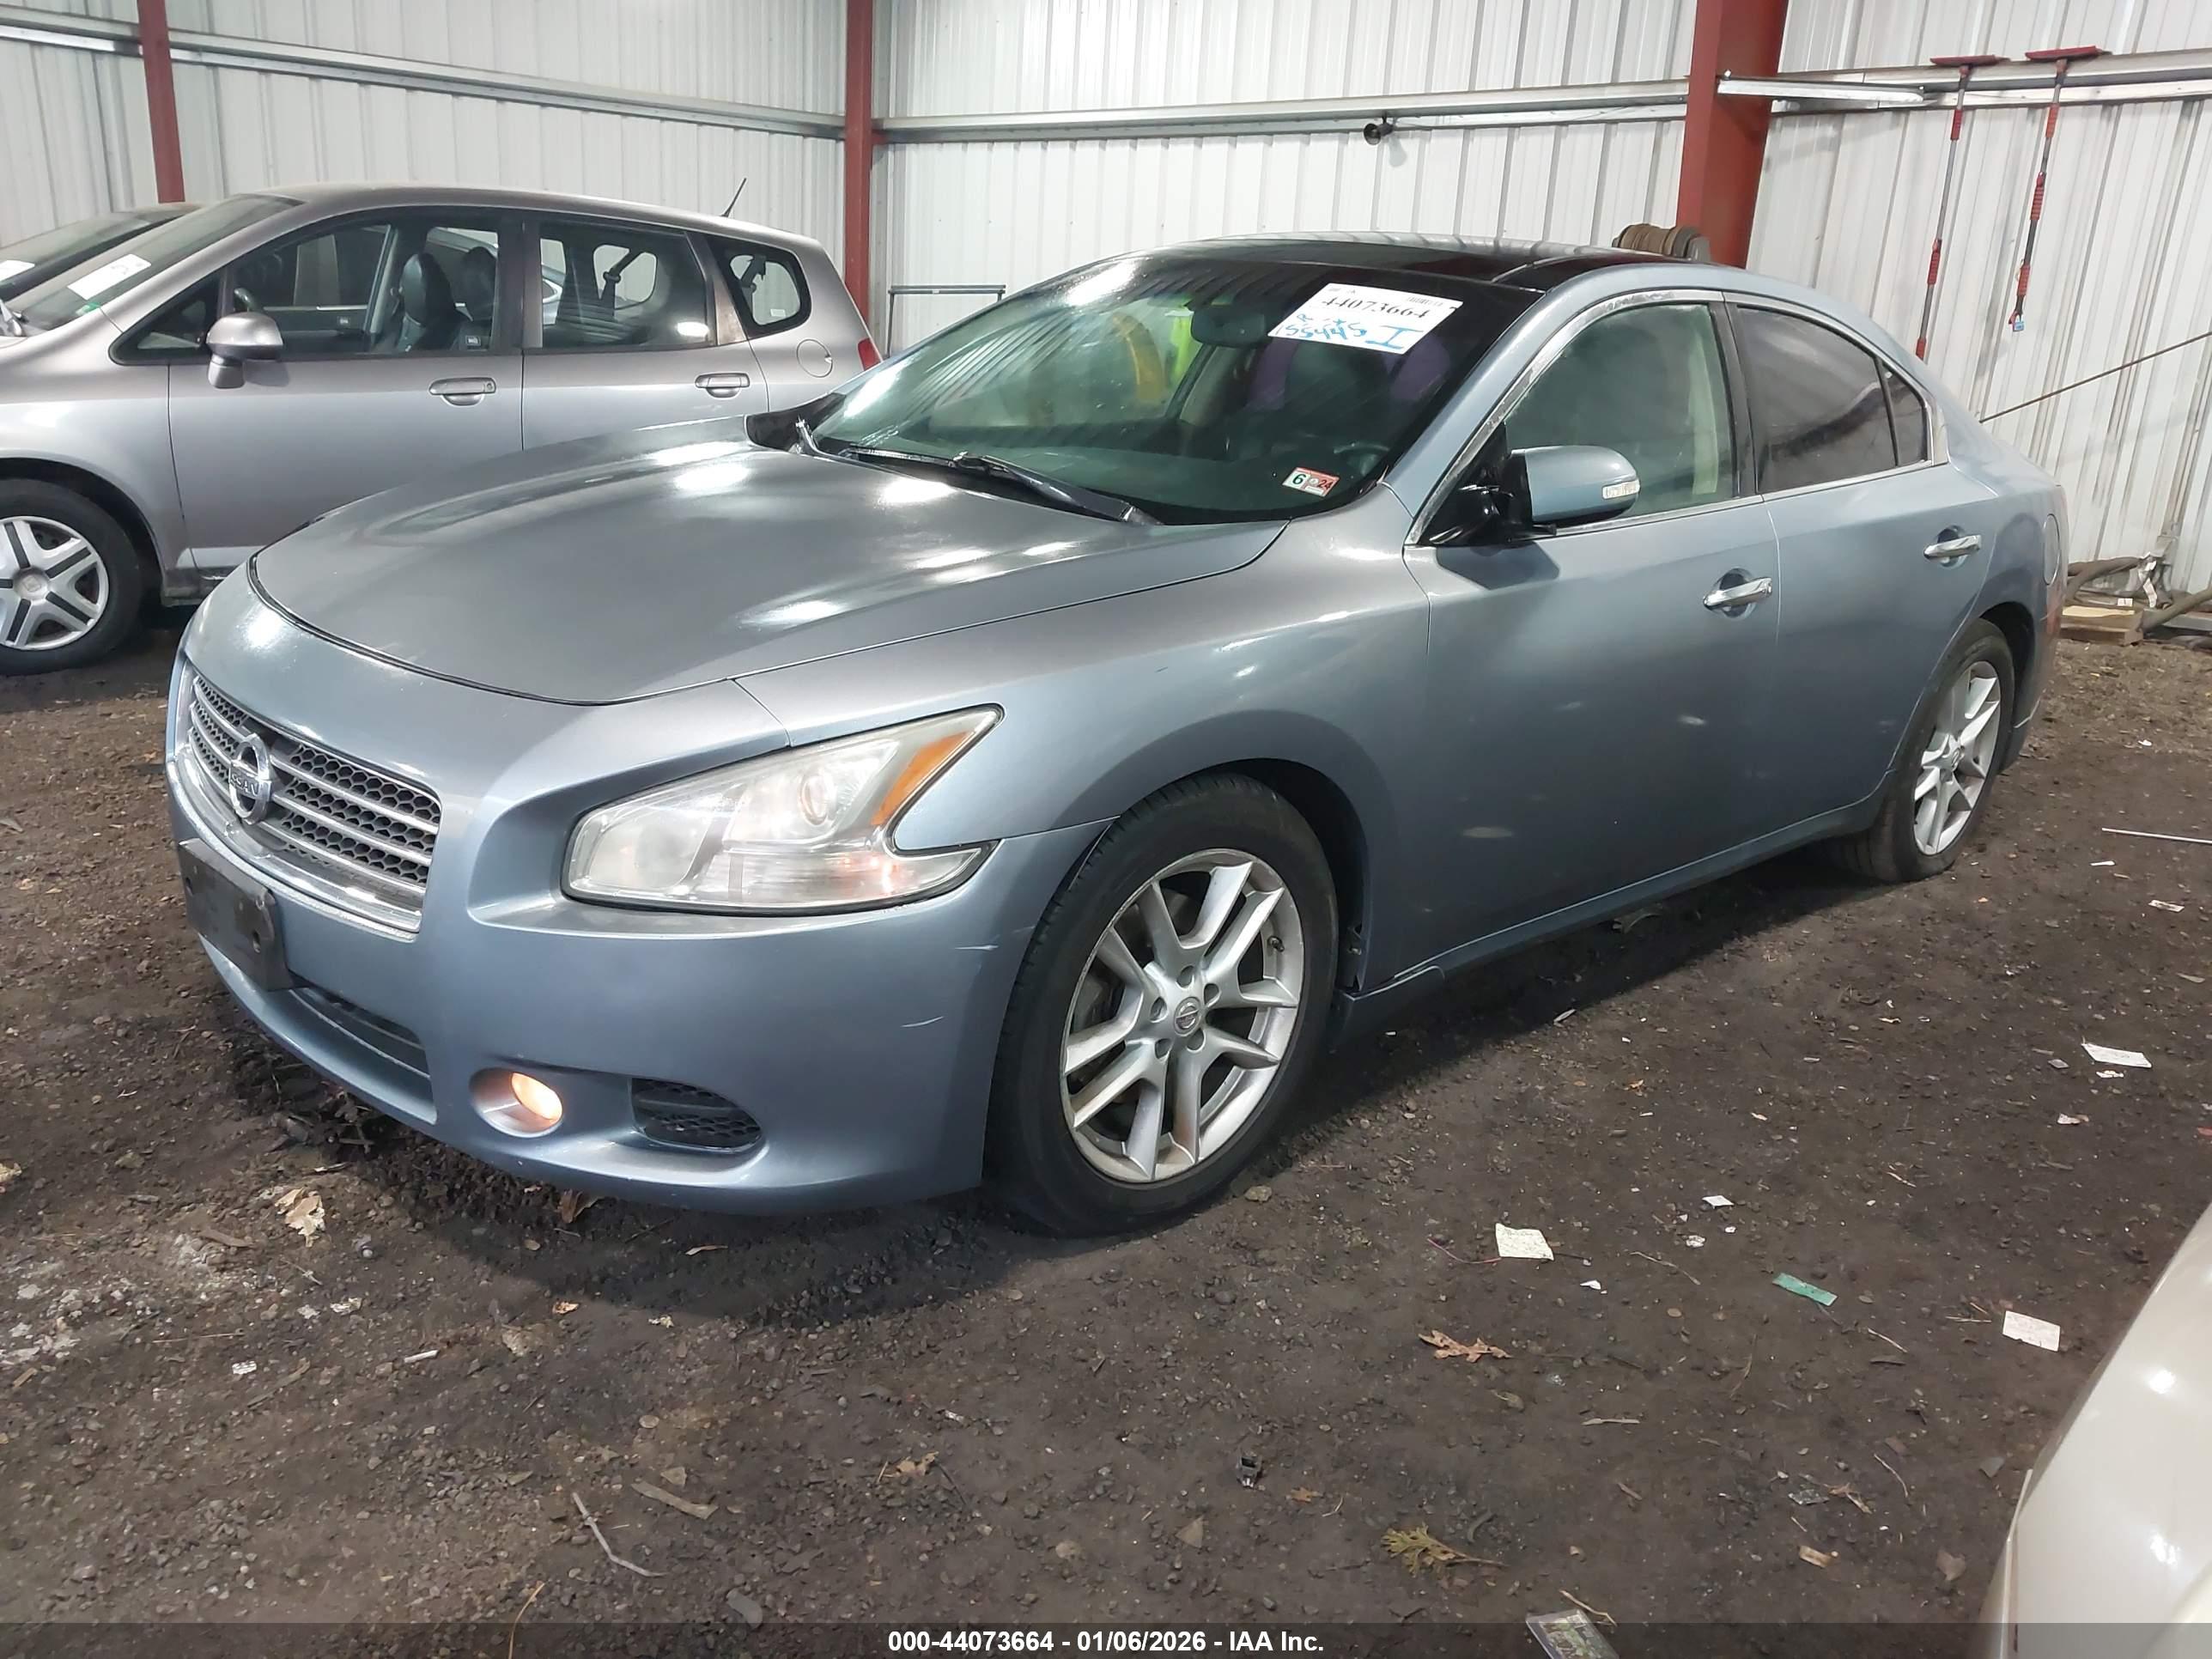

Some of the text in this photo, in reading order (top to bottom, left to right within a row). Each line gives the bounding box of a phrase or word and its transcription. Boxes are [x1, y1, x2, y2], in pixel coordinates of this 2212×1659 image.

[1322, 296, 1431, 319] 44073664
[1291, 473, 1307, 485] 6
[1316, 479, 1334, 490] 24
